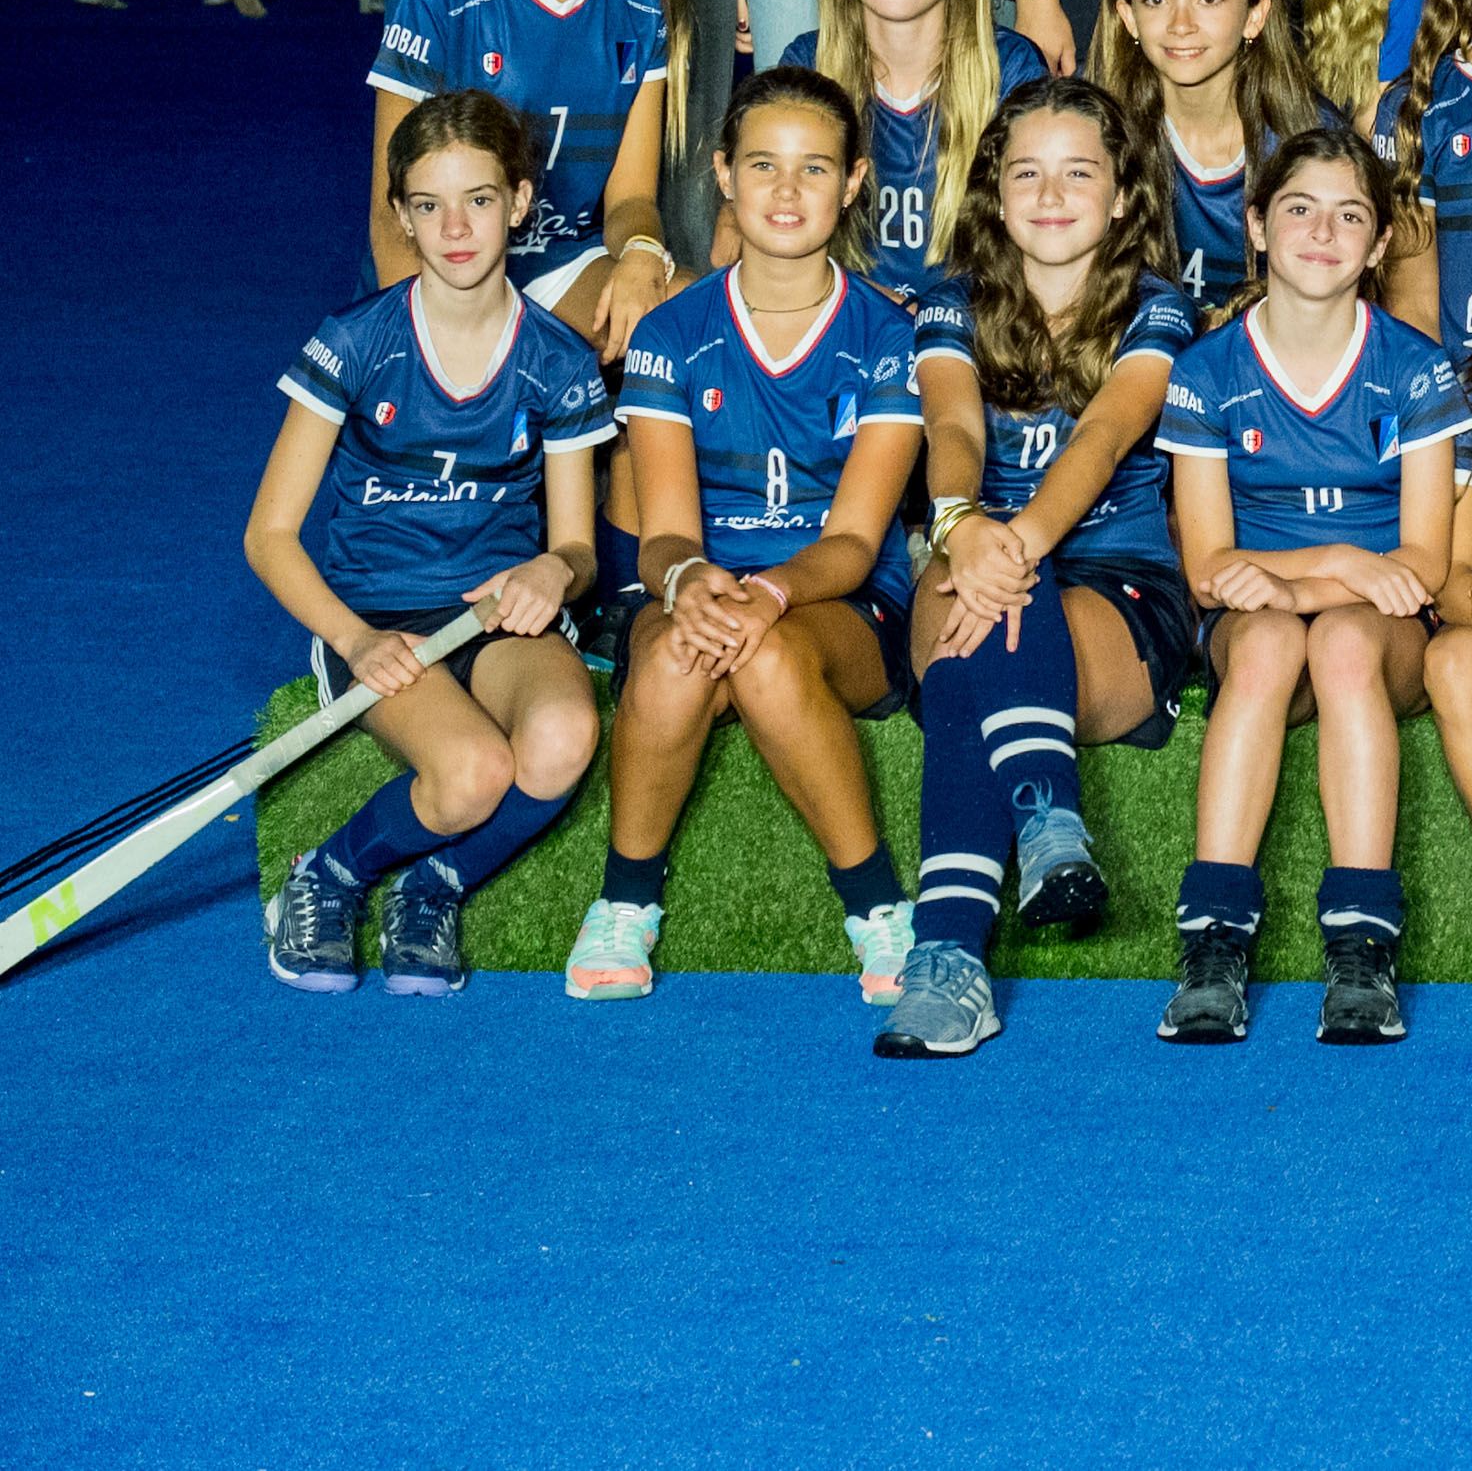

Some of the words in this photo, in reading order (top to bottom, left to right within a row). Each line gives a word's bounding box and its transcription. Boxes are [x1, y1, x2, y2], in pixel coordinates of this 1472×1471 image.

[548, 106, 568, 171] 7
[879, 185, 923, 249] 26
[1182, 247, 1206, 298] 4
[433, 450, 458, 482] 7
[767, 447, 788, 508] 8
